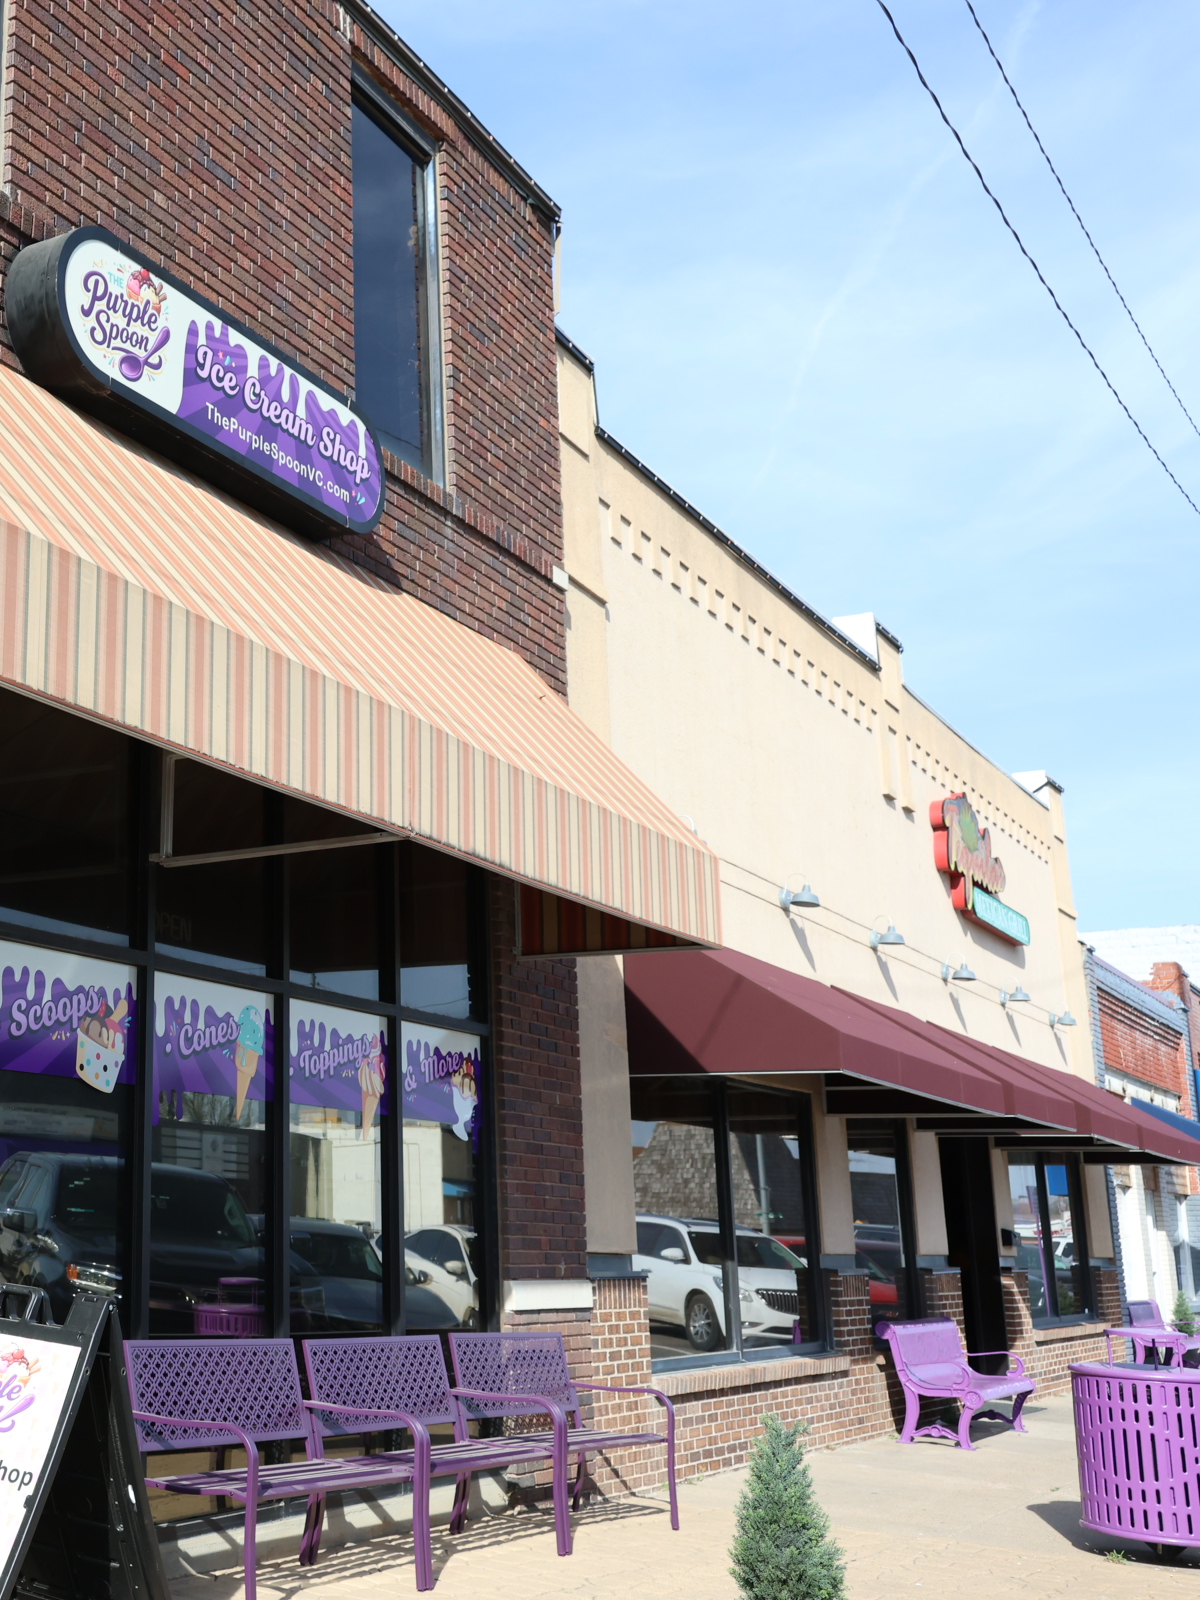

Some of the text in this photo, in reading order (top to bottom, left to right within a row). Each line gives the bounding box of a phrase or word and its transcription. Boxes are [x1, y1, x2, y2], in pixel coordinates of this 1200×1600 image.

[80, 270, 159, 332] Purple
[108, 271, 125, 289] THE
[89, 309, 150, 353] Spoon
[195, 344, 372, 483] Ice Cream Shop
[204, 401, 351, 503] ThePurpleSpoonVC.com
[10, 986, 103, 1037] Scoops
[178, 1016, 241, 1055] Cones
[299, 1034, 373, 1079] Toppings
[404, 1052, 462, 1092] & More
